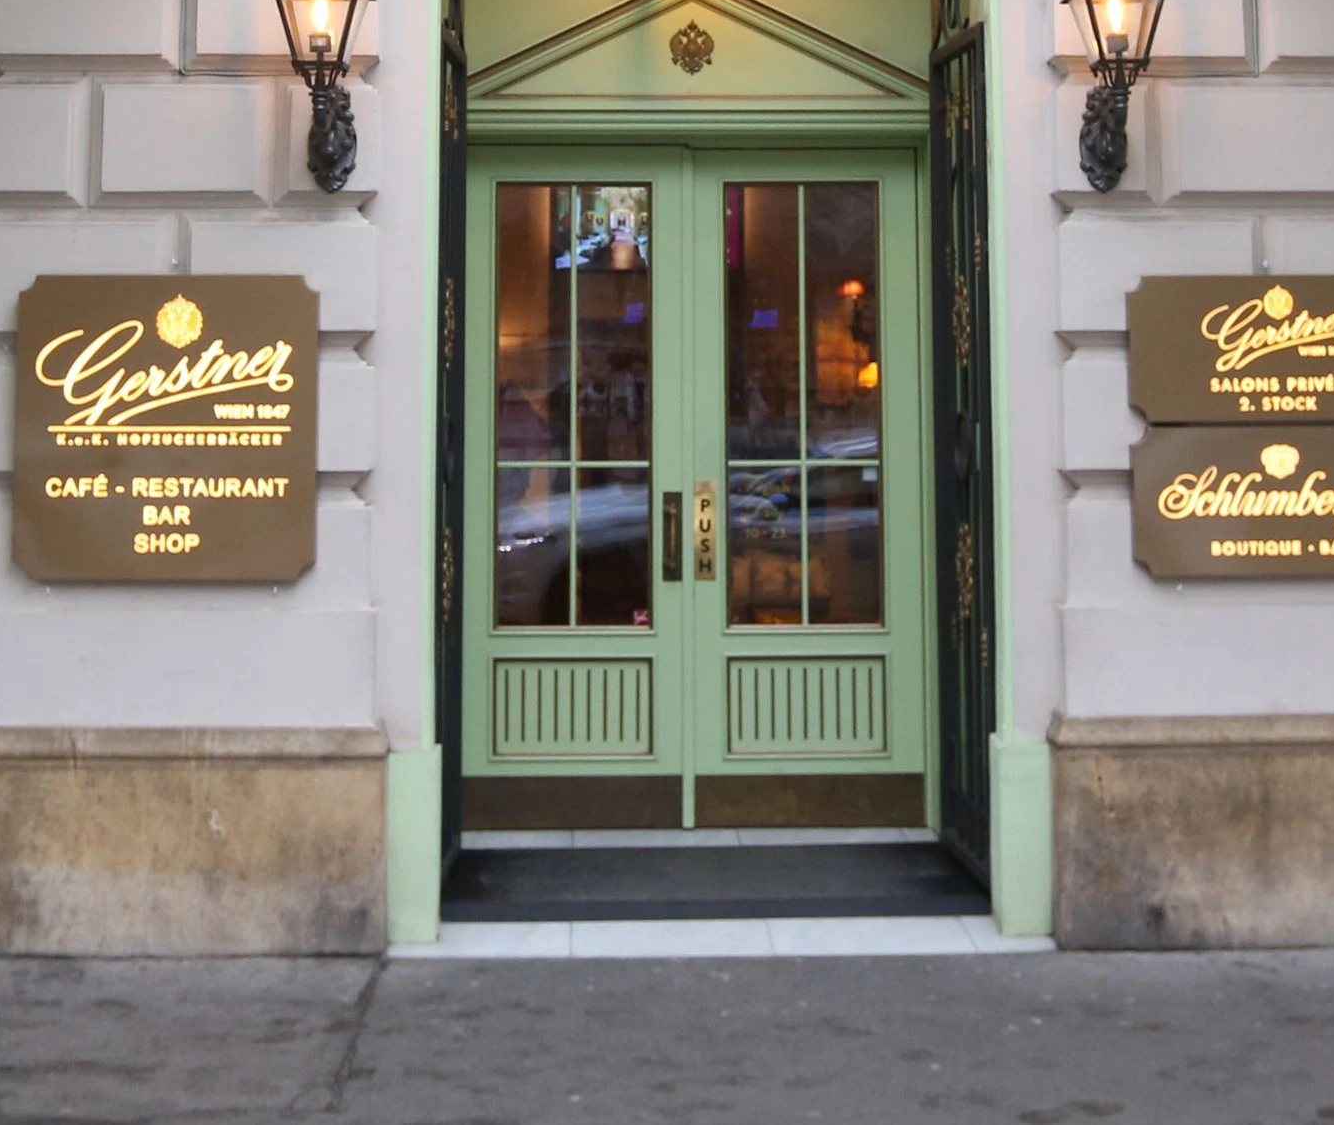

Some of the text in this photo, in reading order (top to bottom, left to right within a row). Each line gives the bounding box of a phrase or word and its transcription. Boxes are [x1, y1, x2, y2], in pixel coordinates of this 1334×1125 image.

[35, 319, 294, 425] Gerstner
[1210, 377, 1280, 393] SALONS
[1239, 396, 1317, 412] 2. STOCK
[45, 473, 109, 498] CAFÉ
[132, 477, 289, 498] RESTAURANT
[142, 505, 190, 525] BAR
[133, 533, 200, 553] SHOP
[699, 499, 711, 572] PUSH
[1210, 540, 1302, 557] BOUTIQUE
